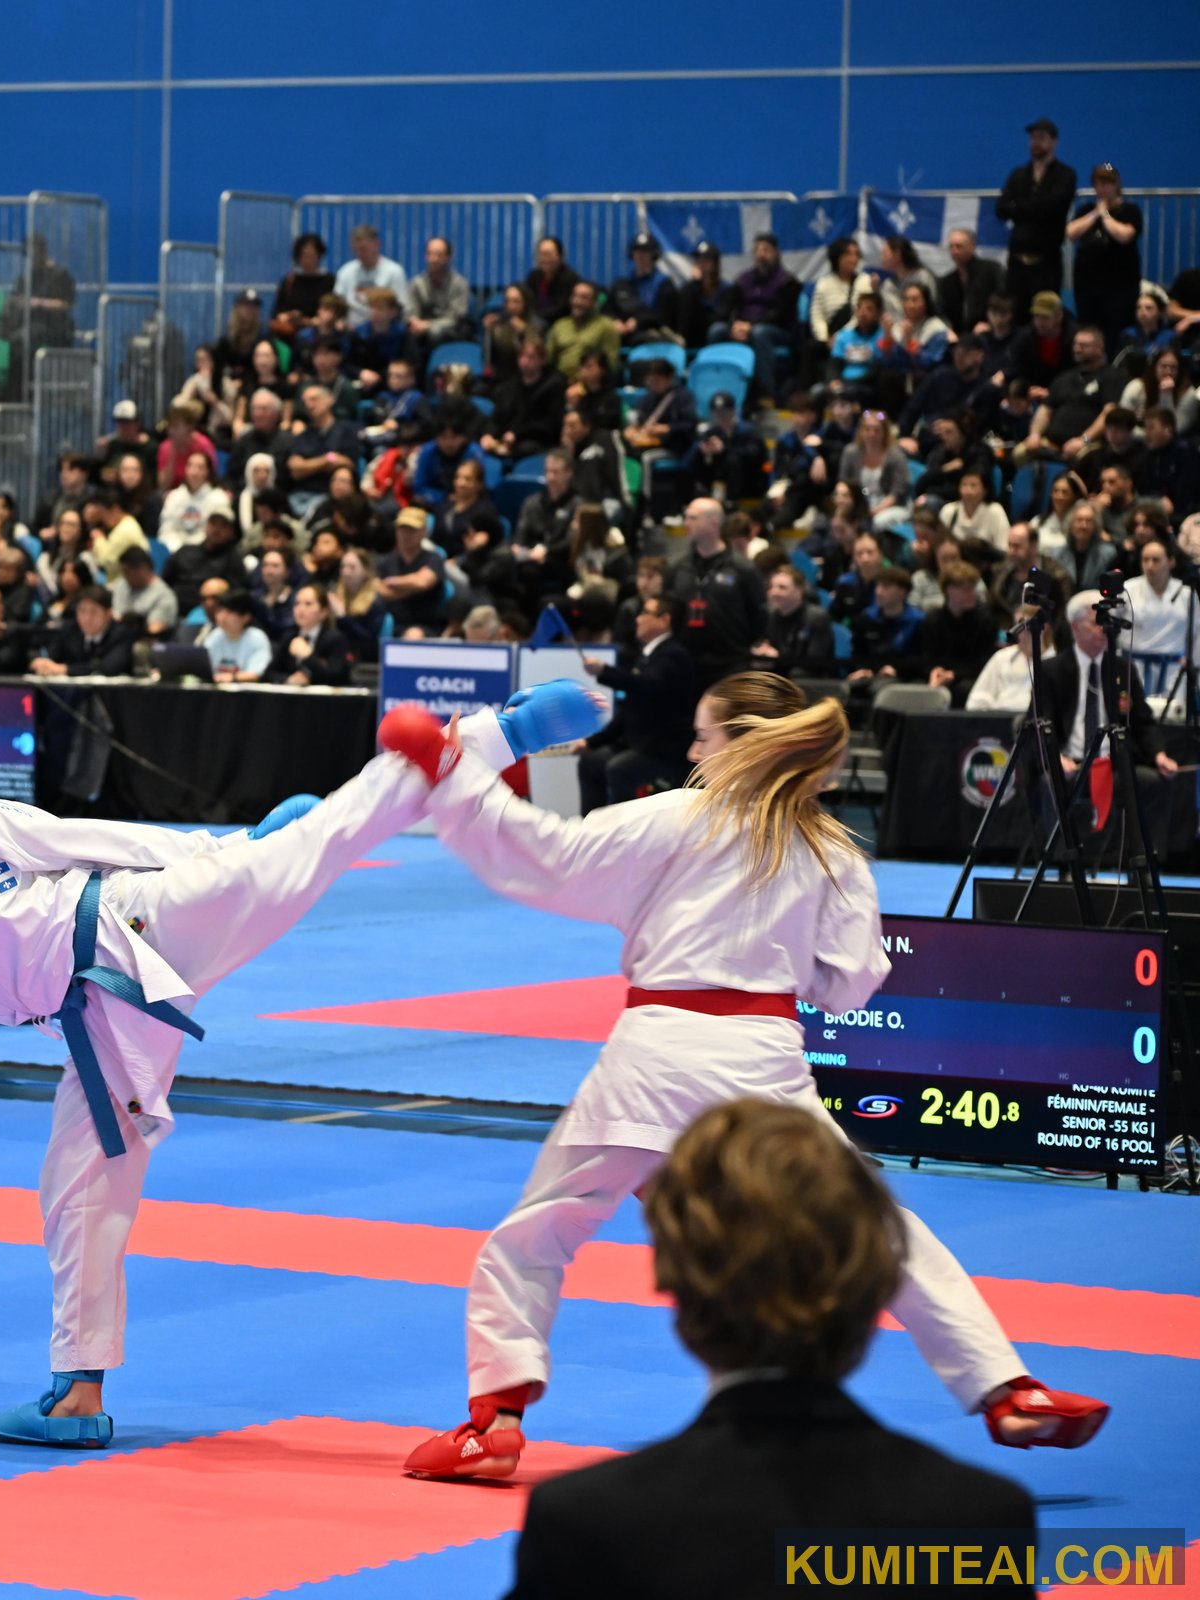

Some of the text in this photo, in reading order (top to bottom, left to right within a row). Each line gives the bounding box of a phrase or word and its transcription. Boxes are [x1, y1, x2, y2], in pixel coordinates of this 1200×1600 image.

[416, 676, 476, 694] COACH
[896, 936, 913, 954] N.
[1135, 949, 1158, 985] 0
[824, 1009, 905, 1030] BRODIE O.
[823, 1029, 837, 1040] QC
[1133, 1026, 1156, 1064] 0
[803, 1051, 846, 1066] ARNING
[834, 1097, 842, 1110] 6
[1047, 1093, 1147, 1115] FÉMININ/FEMALE
[1062, 1115, 1106, 1131] SENIOR
[1109, 1120, 1129, 1133] -55
[1131, 1121, 1148, 1134] KG
[1037, 1132, 1155, 1154] ROUND OF 16 POOL
